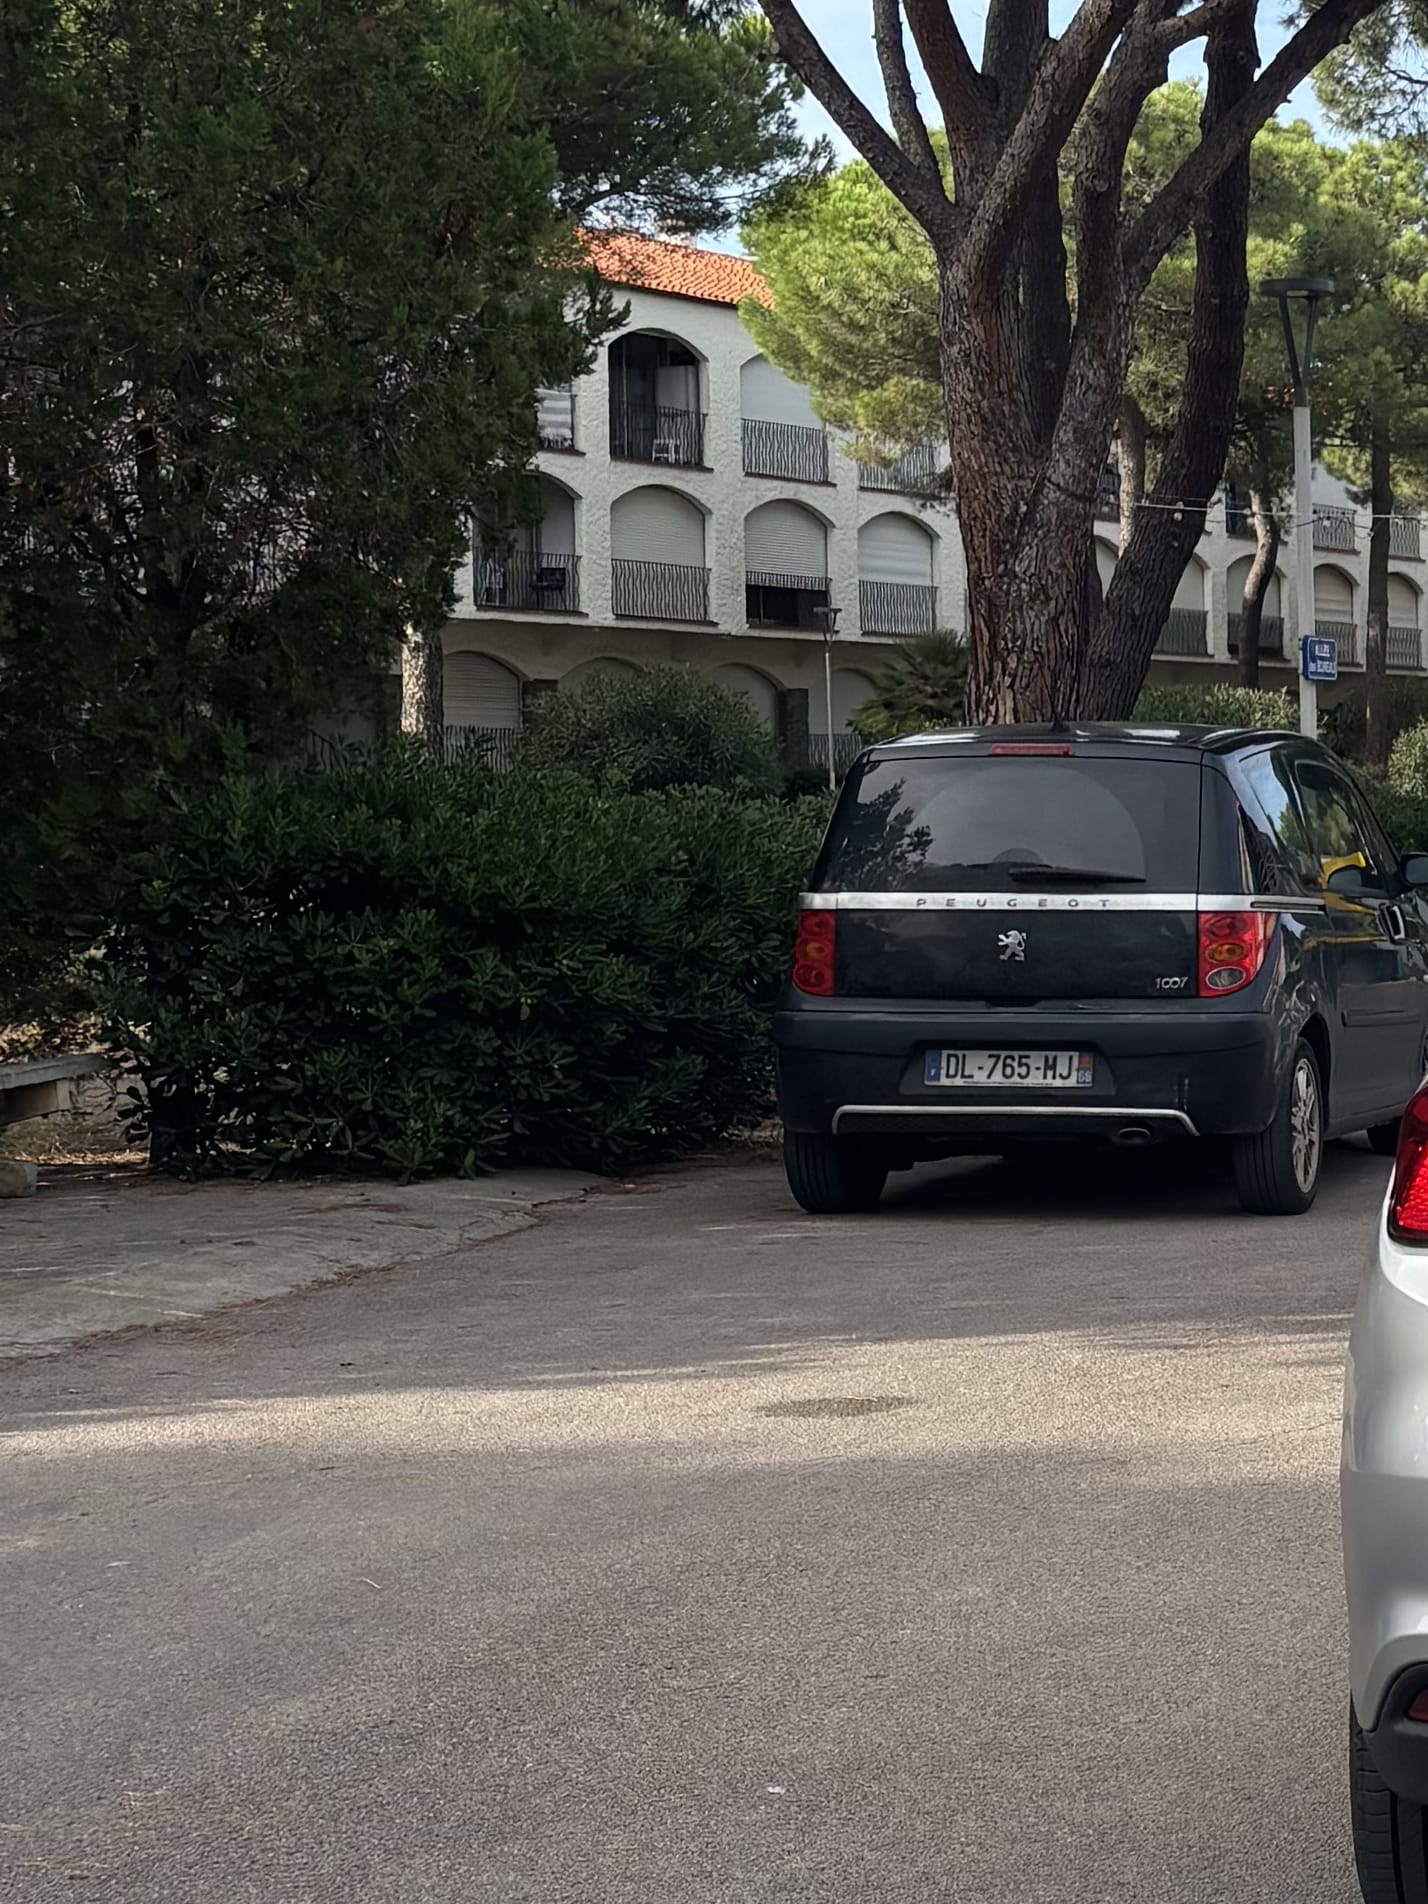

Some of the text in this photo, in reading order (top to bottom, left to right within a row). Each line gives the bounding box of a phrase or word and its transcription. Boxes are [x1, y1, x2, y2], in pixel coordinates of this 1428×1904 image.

[916, 898, 1110, 908] PEUGEOT
[1155, 976, 1189, 989] 1007
[945, 1053, 1073, 1080] DL-765-MJ
